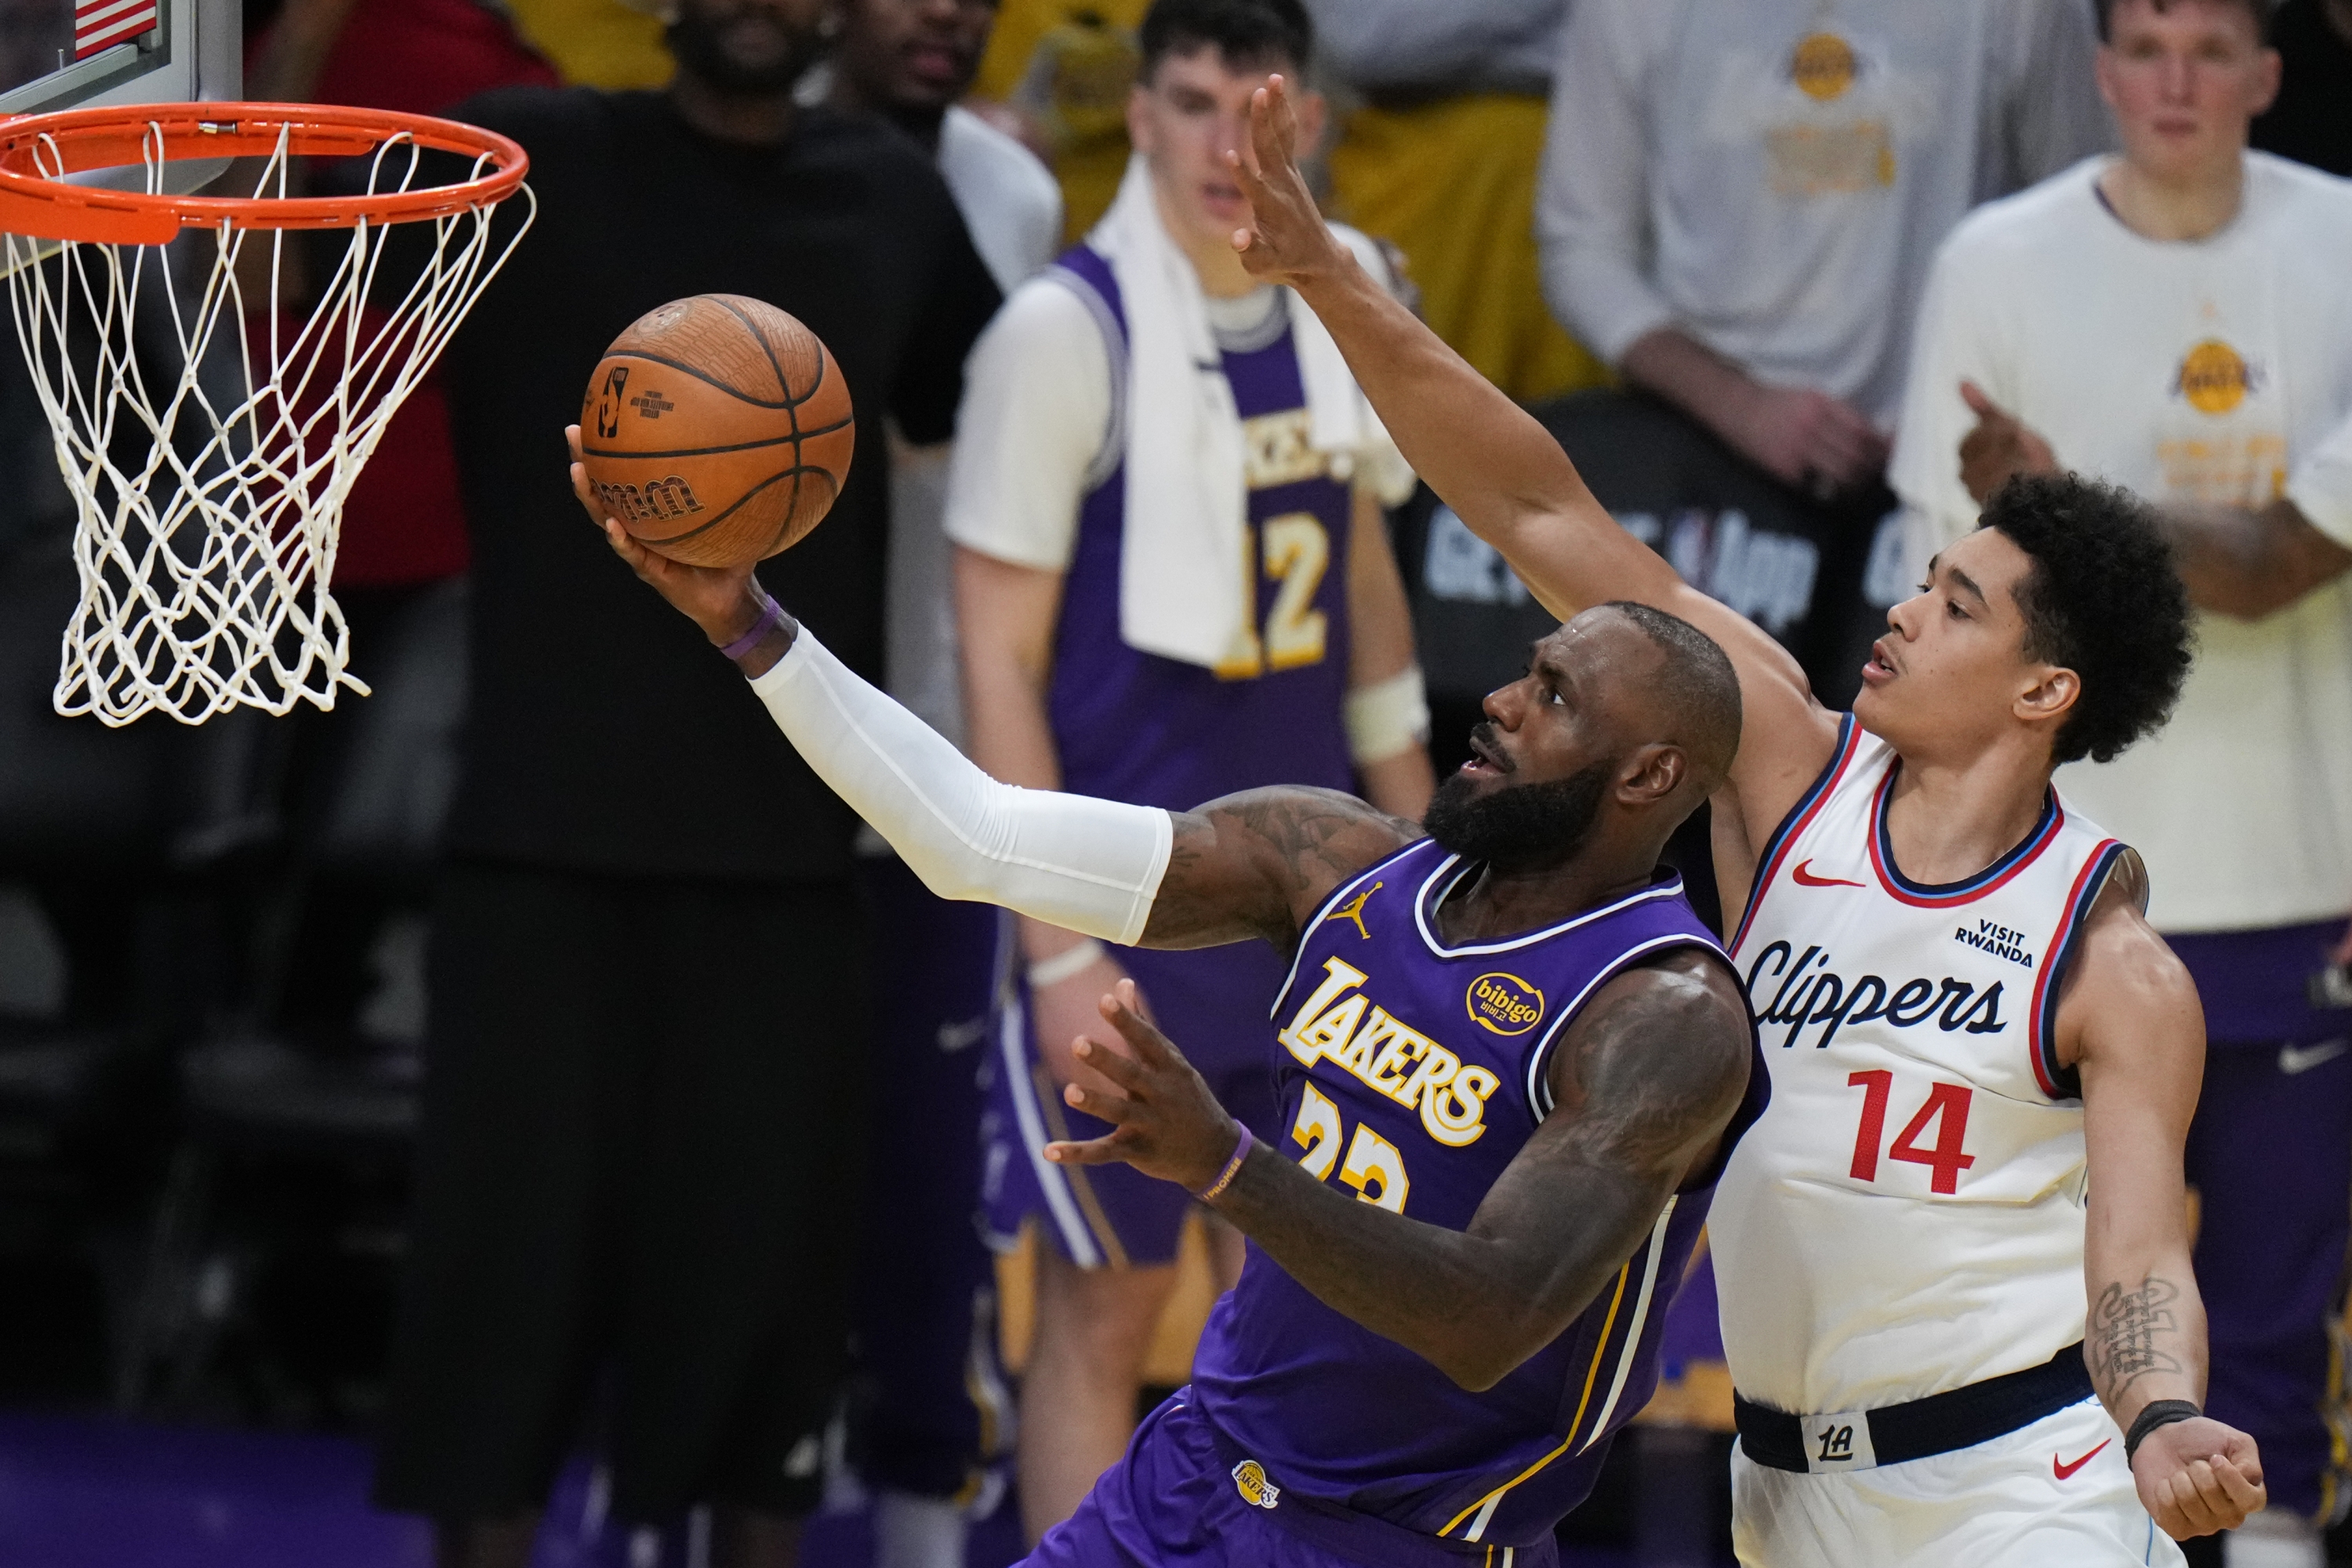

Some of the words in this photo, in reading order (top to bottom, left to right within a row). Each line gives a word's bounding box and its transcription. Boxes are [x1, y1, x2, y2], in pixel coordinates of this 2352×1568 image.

[1955, 927, 2032, 968] RWANDA
[1980, 918, 2025, 946] VISIT
[1476, 979, 1537, 1023] bibigo
[1480, 1001, 1507, 1022] 비비고
[1746, 940, 2008, 1049] Clippers
[1277, 955, 1501, 1147] LAKERS
[1848, 1069, 1976, 1195] 14
[1208, 1157, 1242, 1197] PROMISE
[1818, 1424, 1853, 1462] LA
[1233, 1463, 1276, 1507] LAKERS
